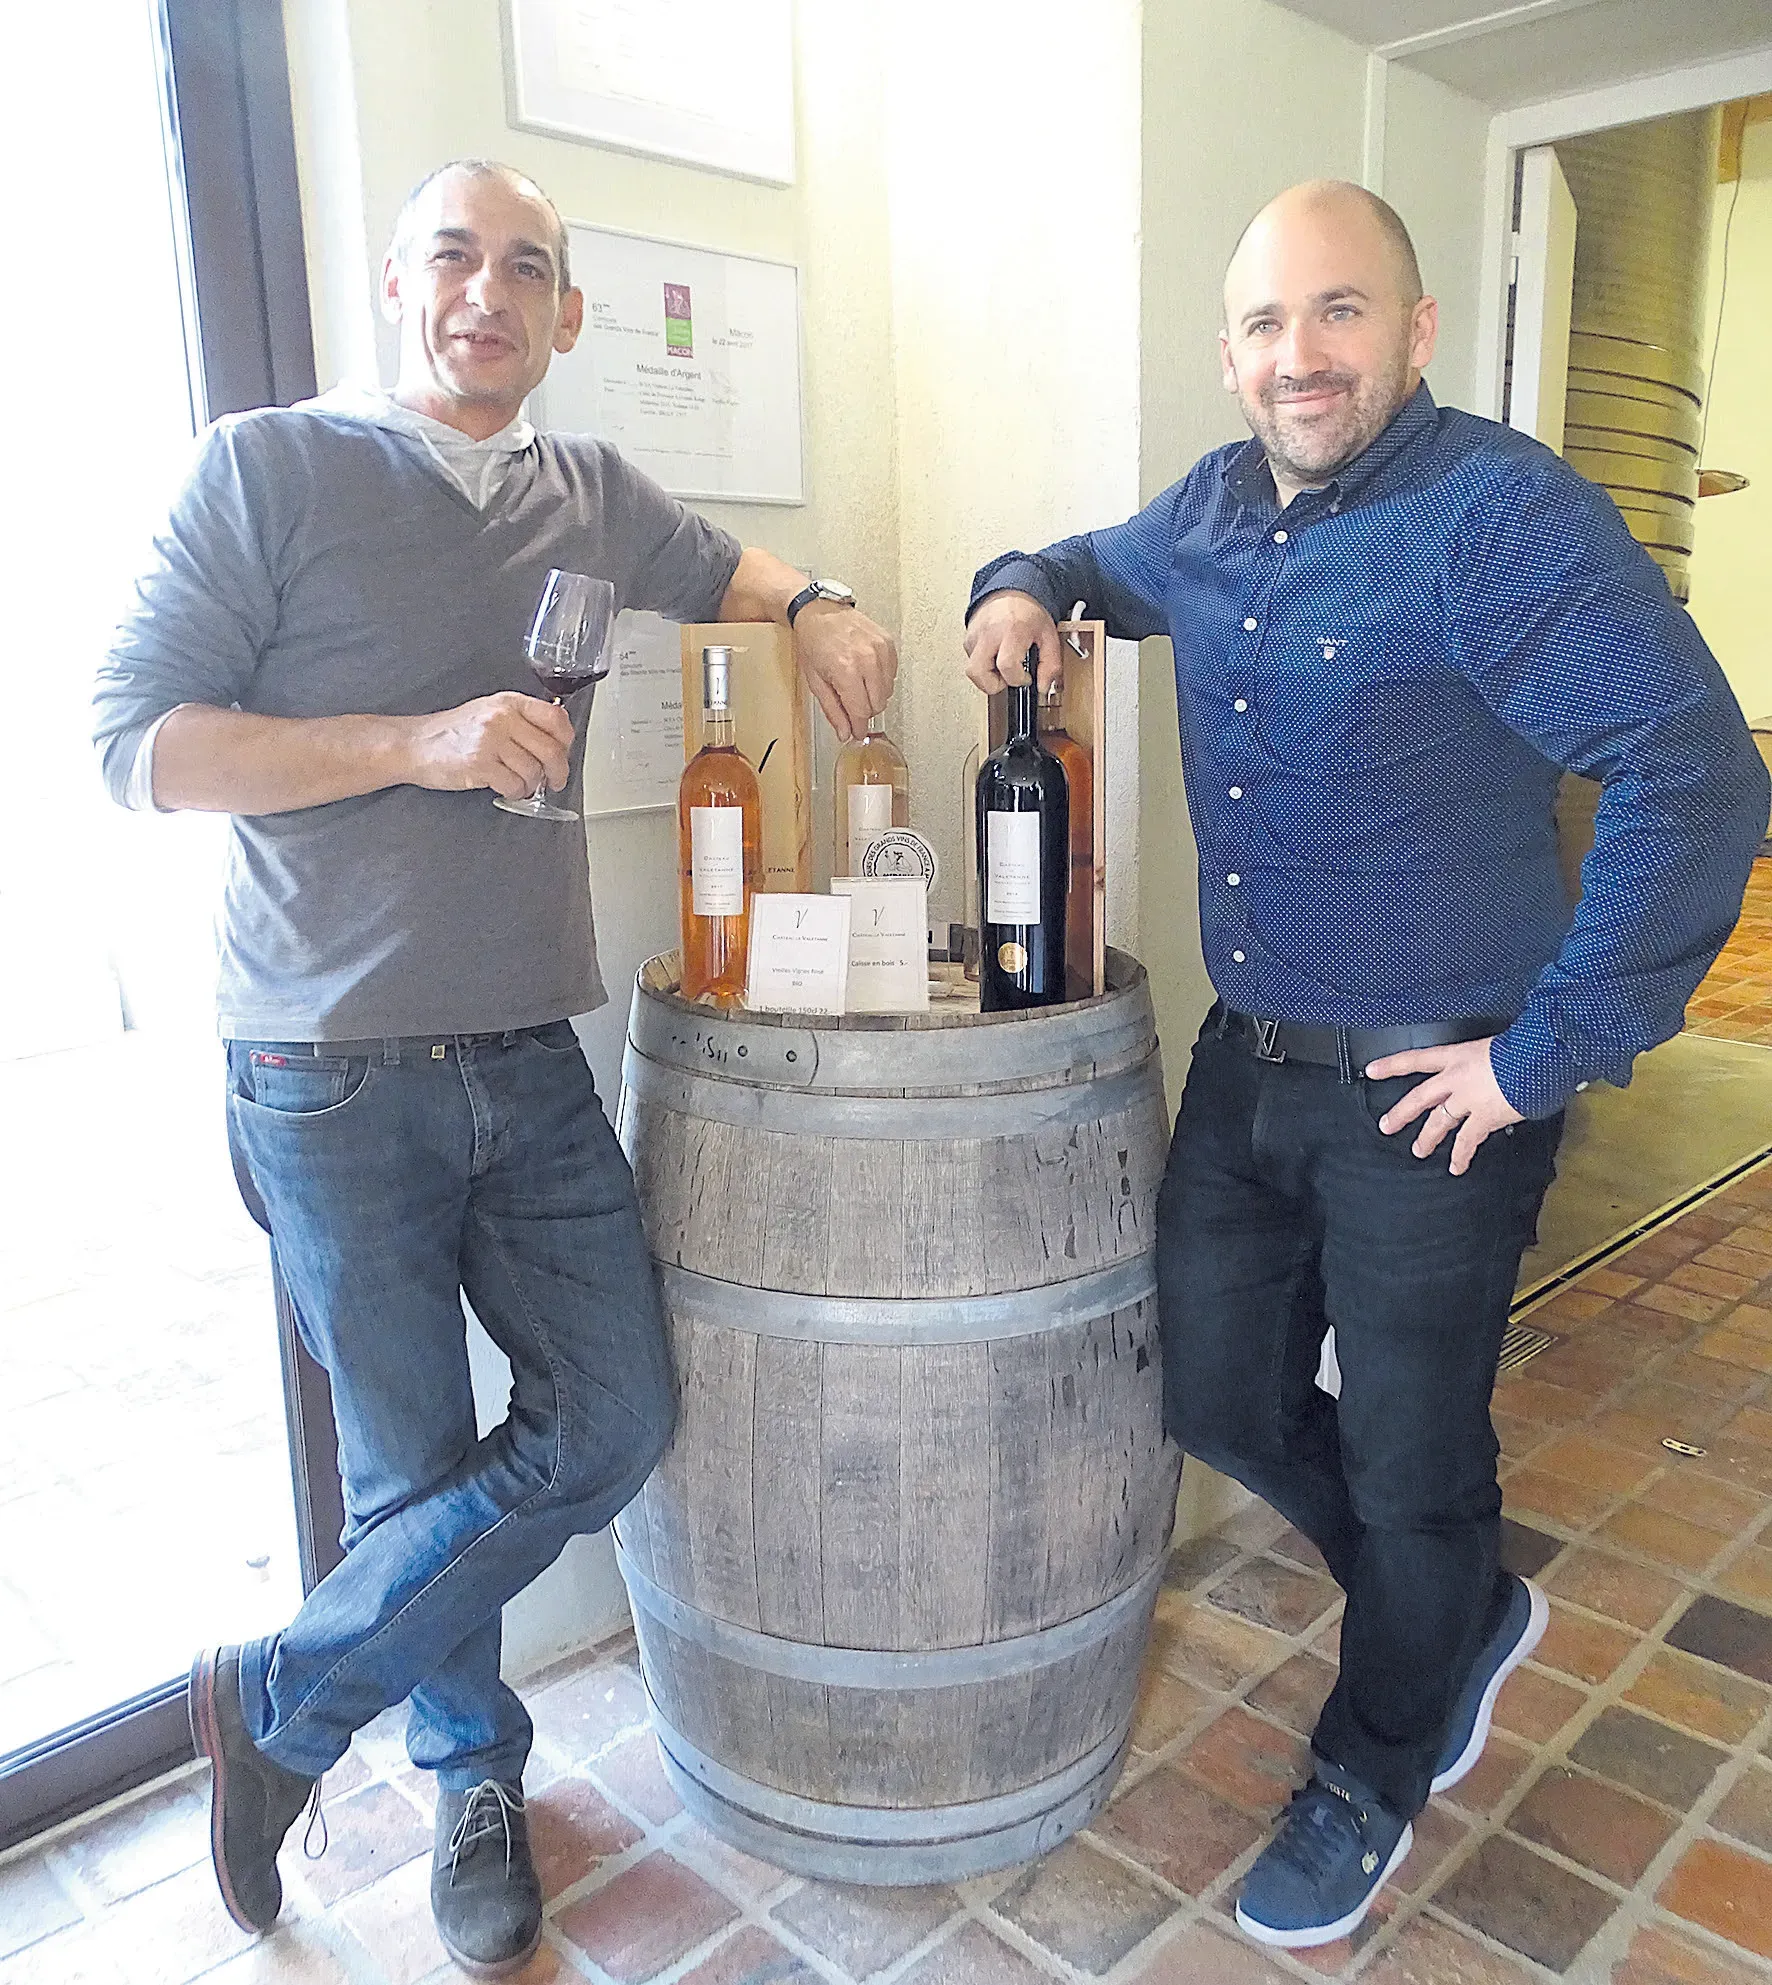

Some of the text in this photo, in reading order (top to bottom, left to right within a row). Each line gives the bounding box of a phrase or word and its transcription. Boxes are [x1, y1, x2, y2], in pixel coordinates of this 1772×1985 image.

[661, 700, 683, 710] Méda
[896, 836, 910, 844] VINS
[881, 959, 895, 967] bois
